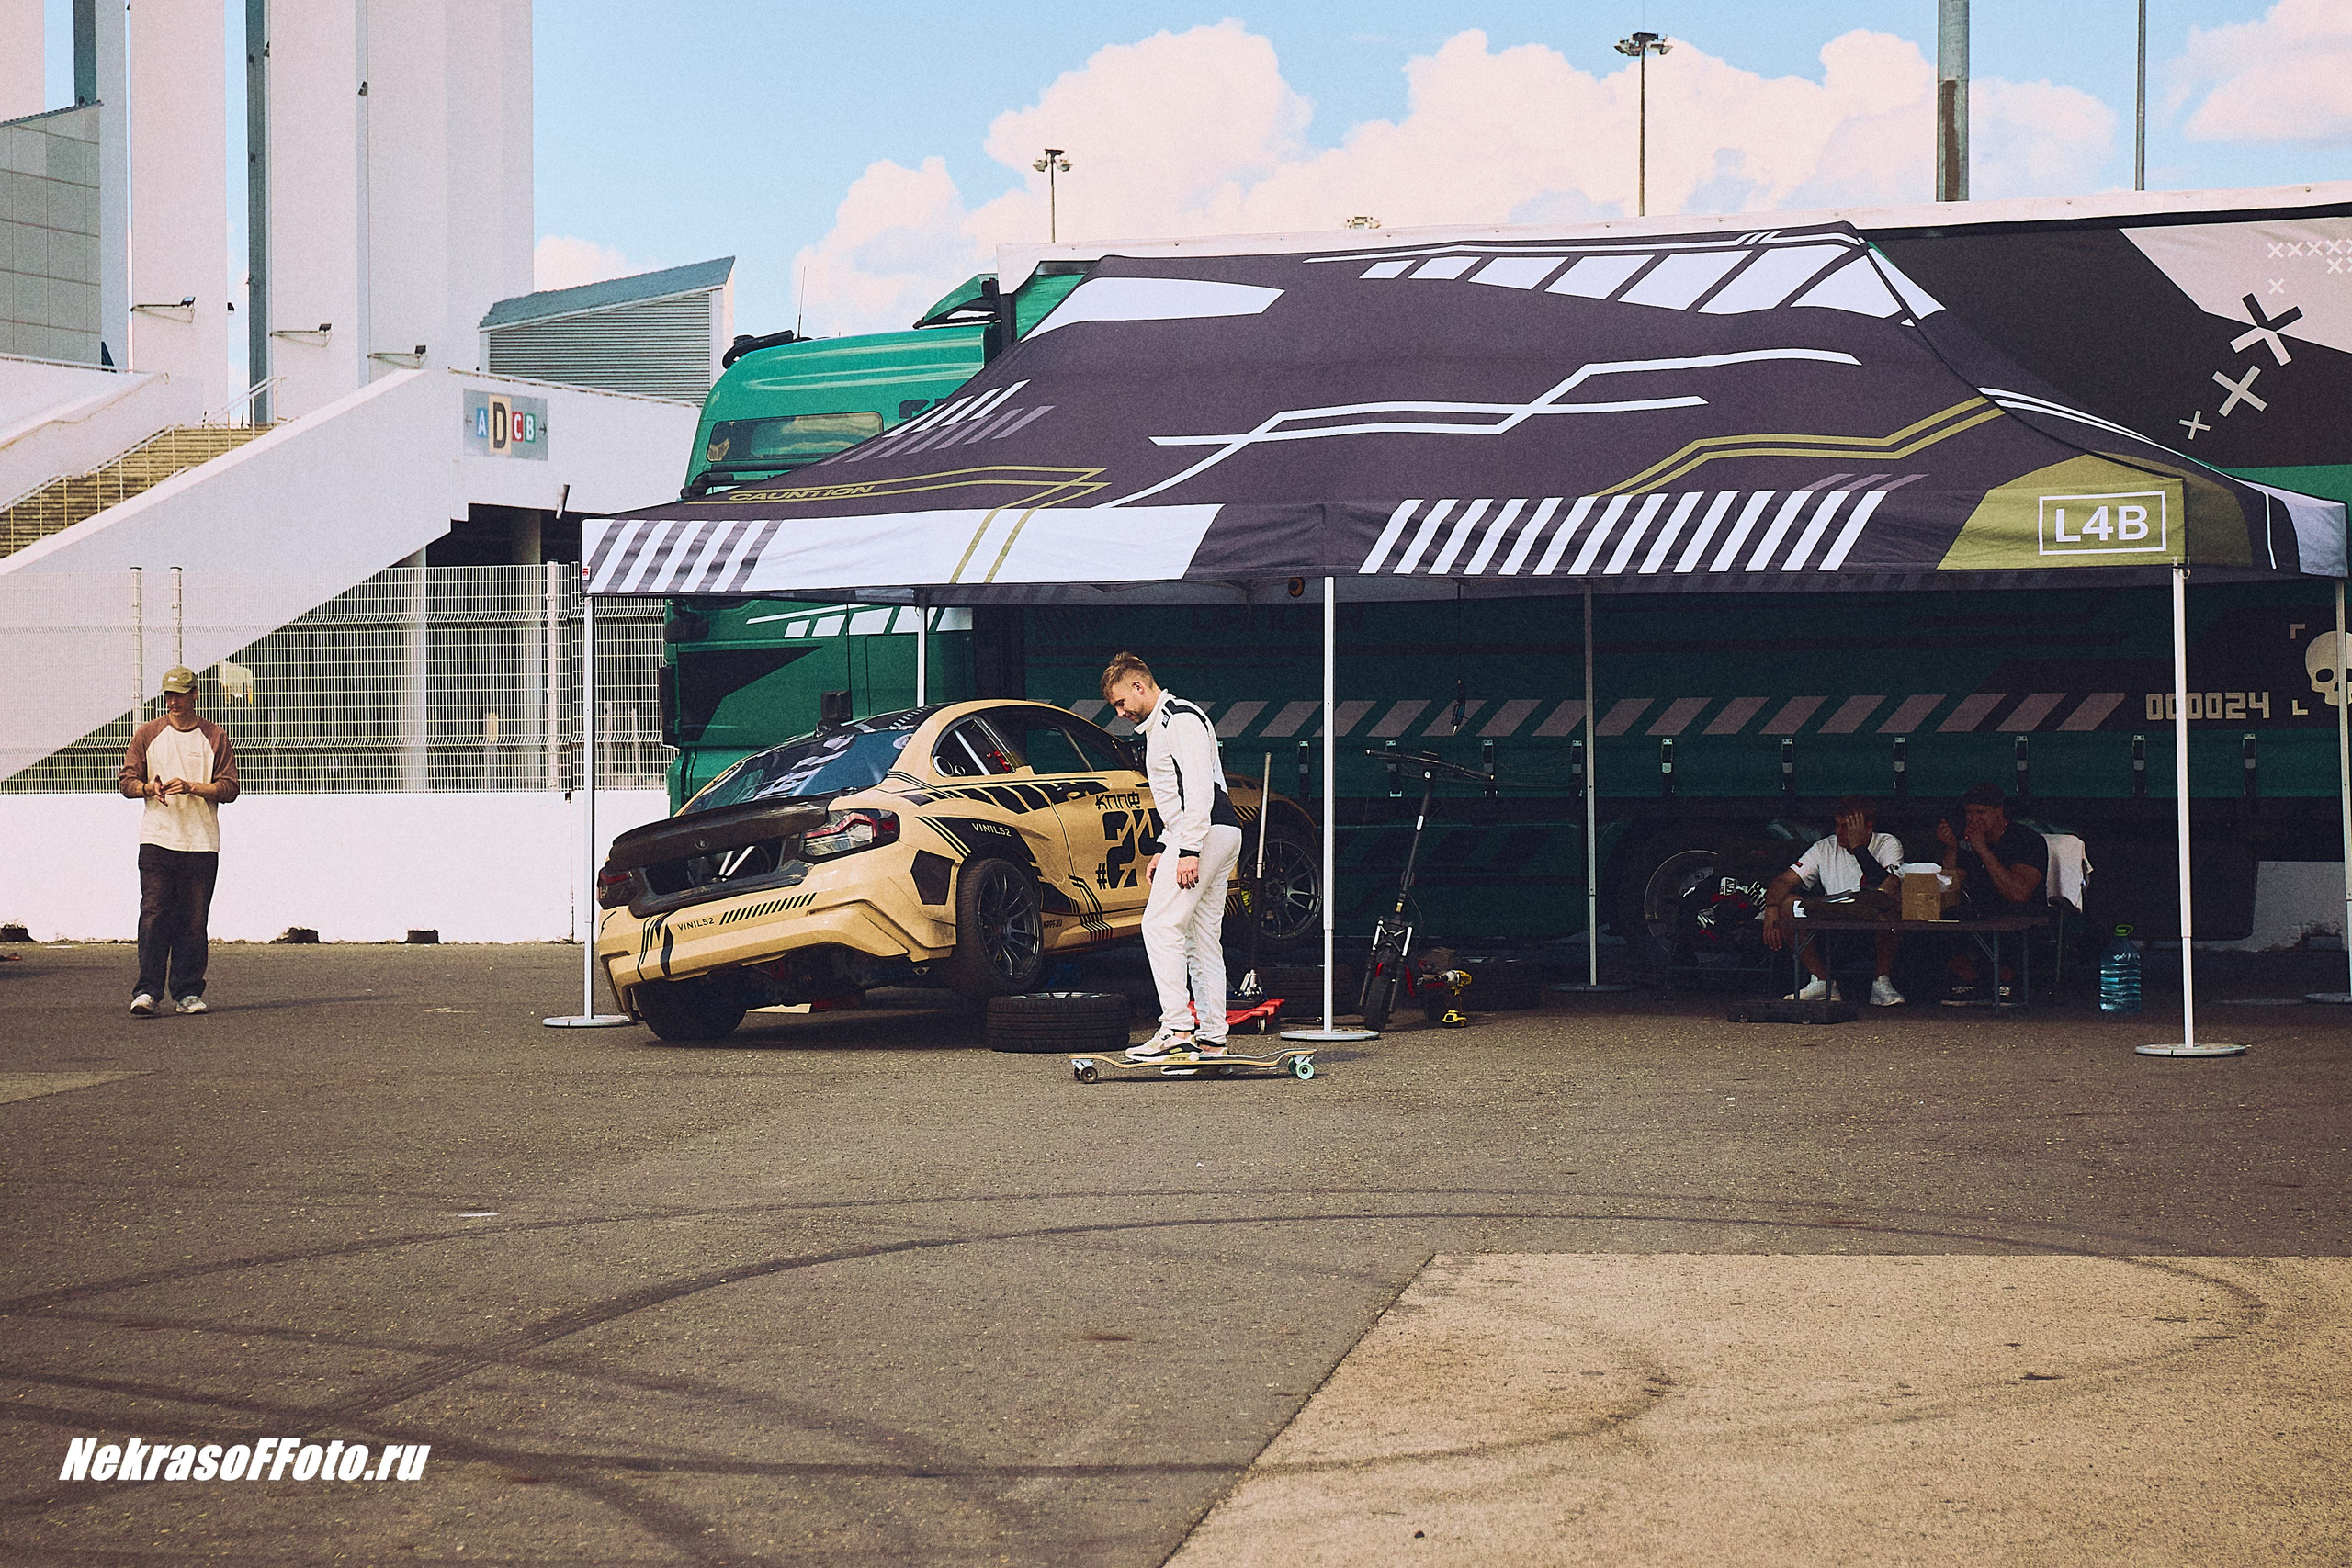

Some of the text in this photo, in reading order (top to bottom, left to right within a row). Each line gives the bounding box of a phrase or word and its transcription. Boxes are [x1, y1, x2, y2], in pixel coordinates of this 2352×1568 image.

[493, 401, 507, 449] D
[729, 485, 875, 502] CAUNTION
[2055, 504, 2150, 543] L4B
[971, 822, 1012, 837] VINIL52
[677, 917, 715, 931] VINIL52
